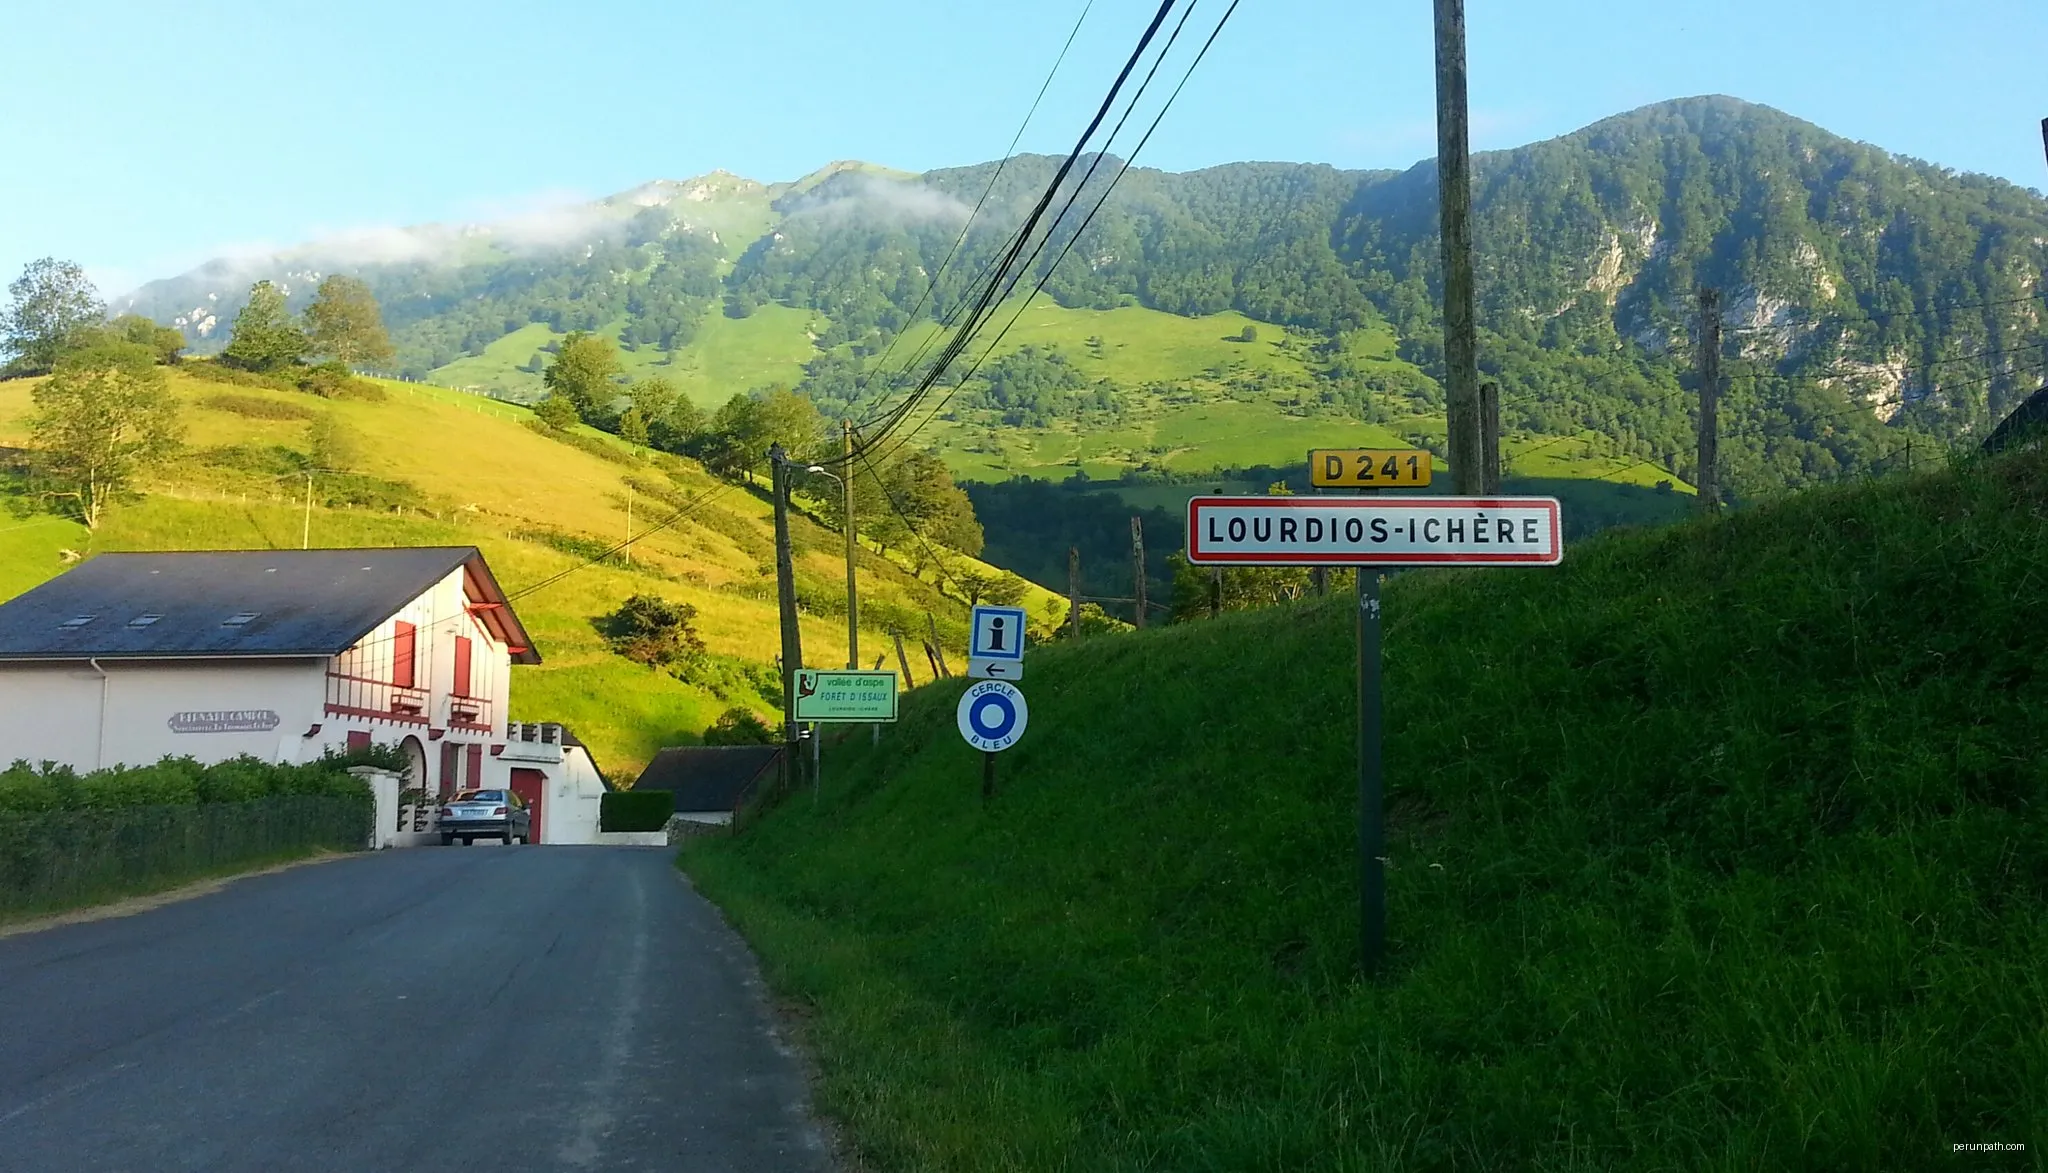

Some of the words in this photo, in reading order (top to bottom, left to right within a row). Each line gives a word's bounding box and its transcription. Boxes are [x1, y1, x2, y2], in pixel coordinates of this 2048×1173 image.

[1326, 455, 1343, 481] D
[1356, 455, 1421, 481] 241
[1208, 512, 1540, 544] LOURDIOS-ICHÈRE
[971, 682, 1016, 698] CERCLE
[971, 734, 1013, 750] BLEU
